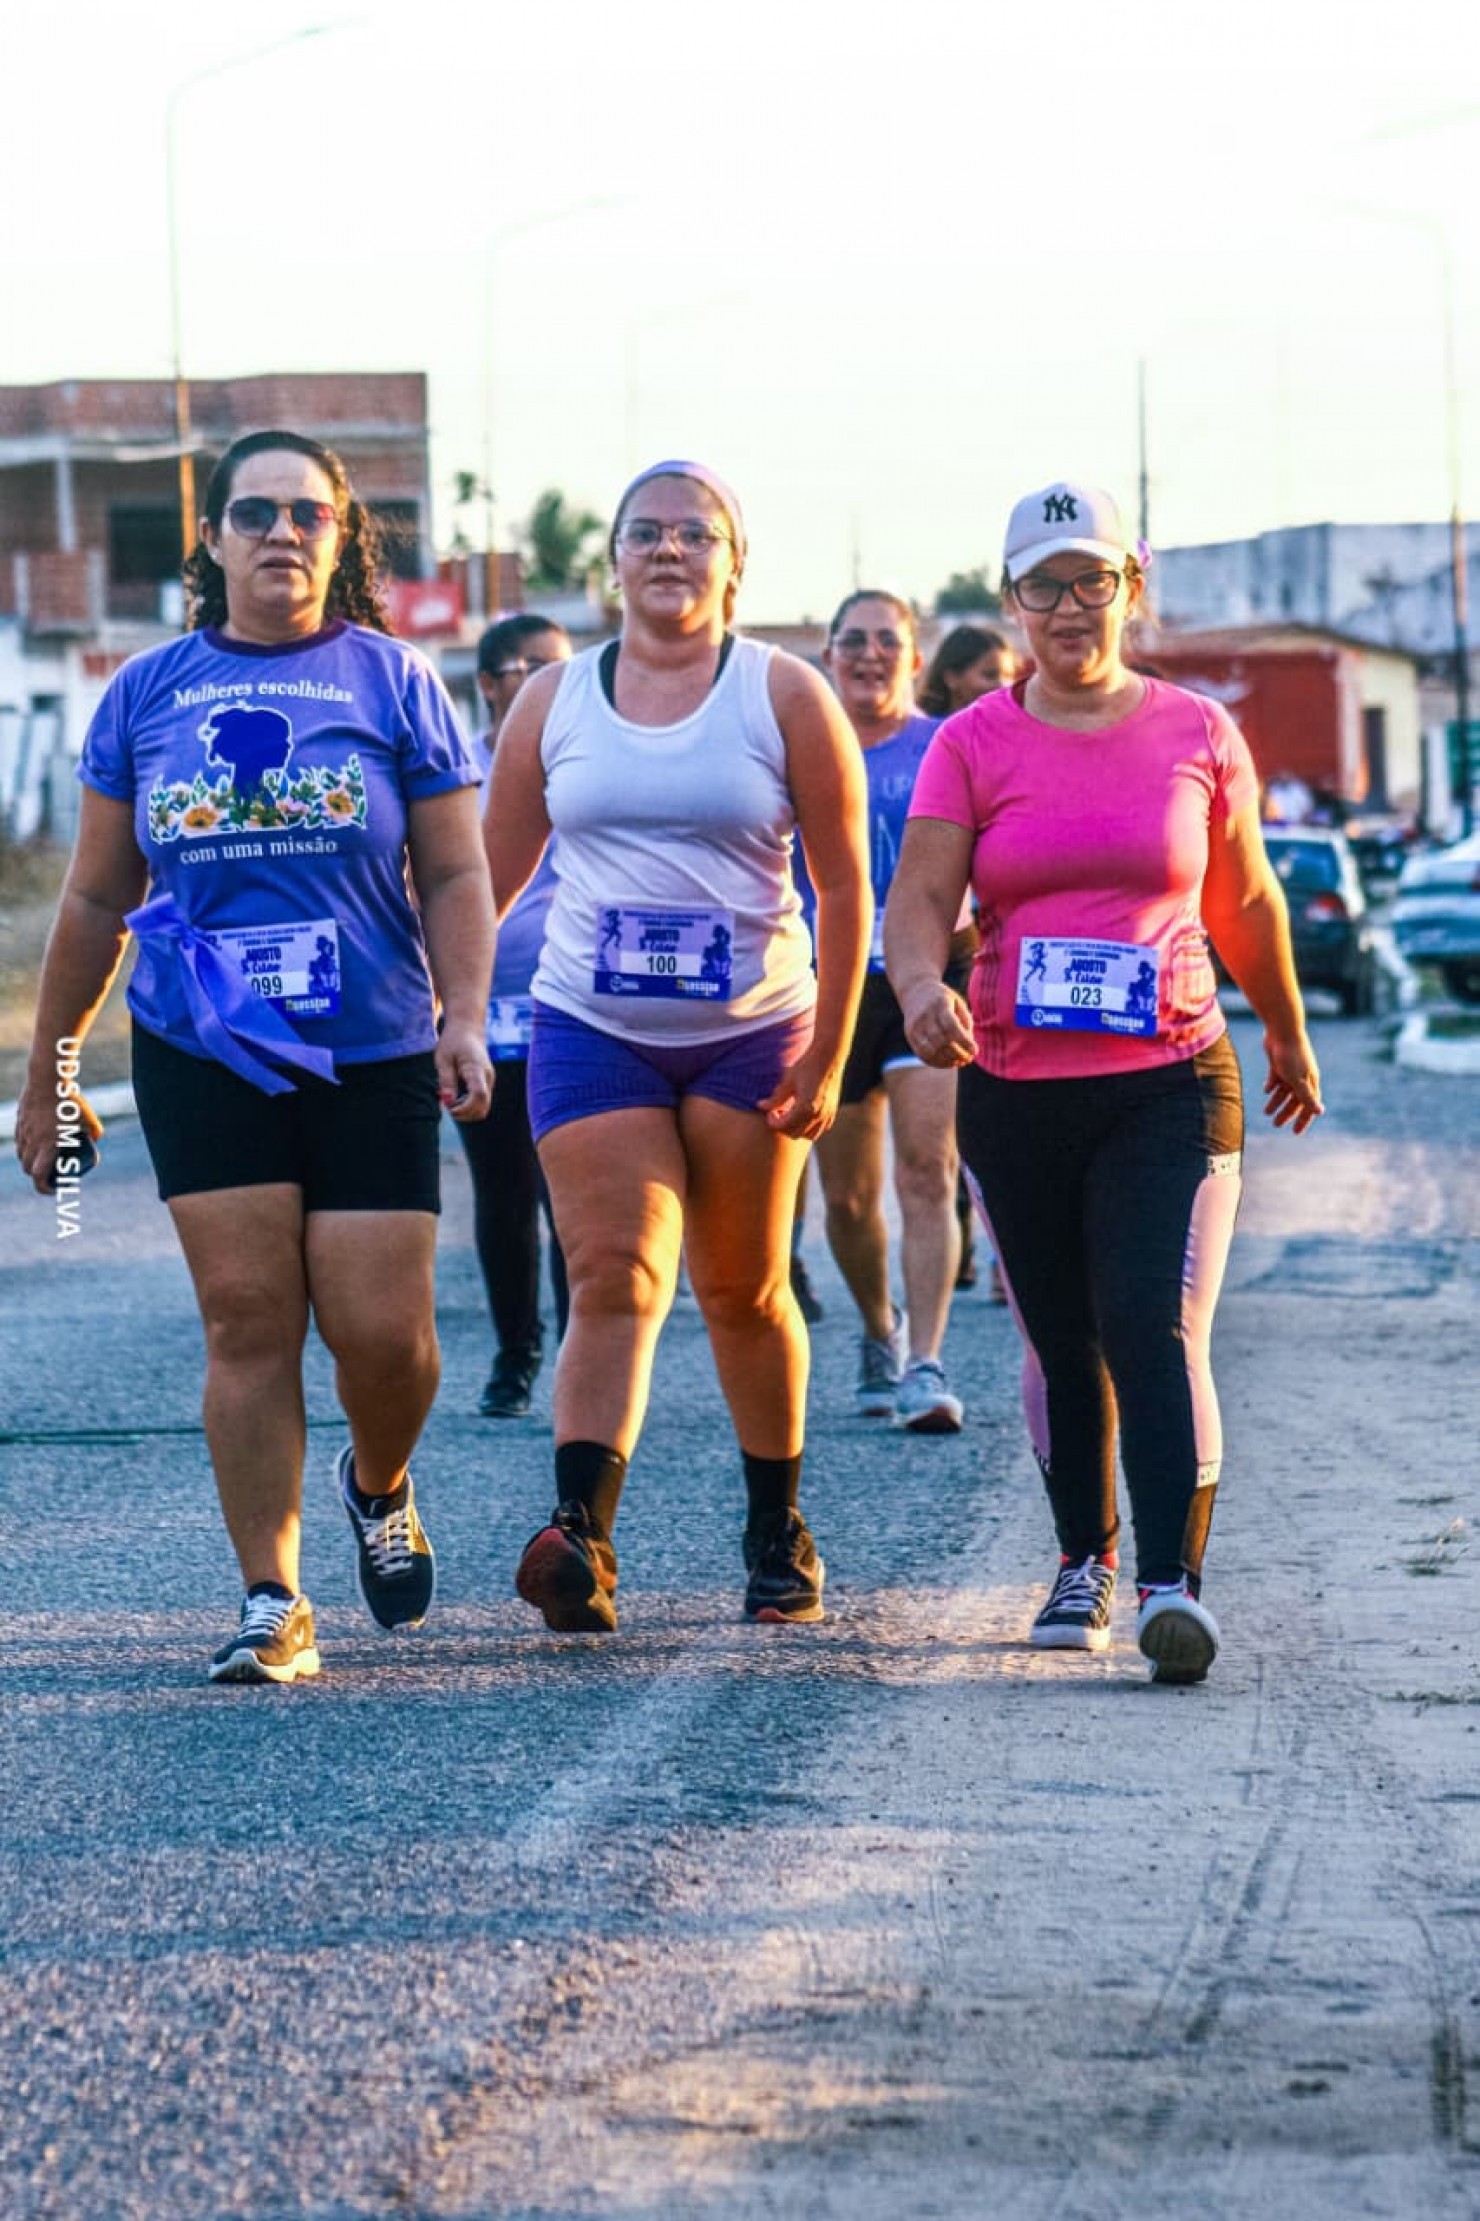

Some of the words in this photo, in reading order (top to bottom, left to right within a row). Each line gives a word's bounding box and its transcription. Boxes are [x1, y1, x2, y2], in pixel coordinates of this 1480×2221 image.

[1043, 493, 1078, 523] NY
[173, 682, 252, 708] Mulheres
[257, 680, 355, 703] escolhidas
[180, 848, 217, 865] com
[222, 842, 264, 860] uma
[270, 835, 338, 855] missão
[647, 955, 676, 974] 100
[251, 975, 282, 996] 099
[1070, 986, 1103, 1006] 023
